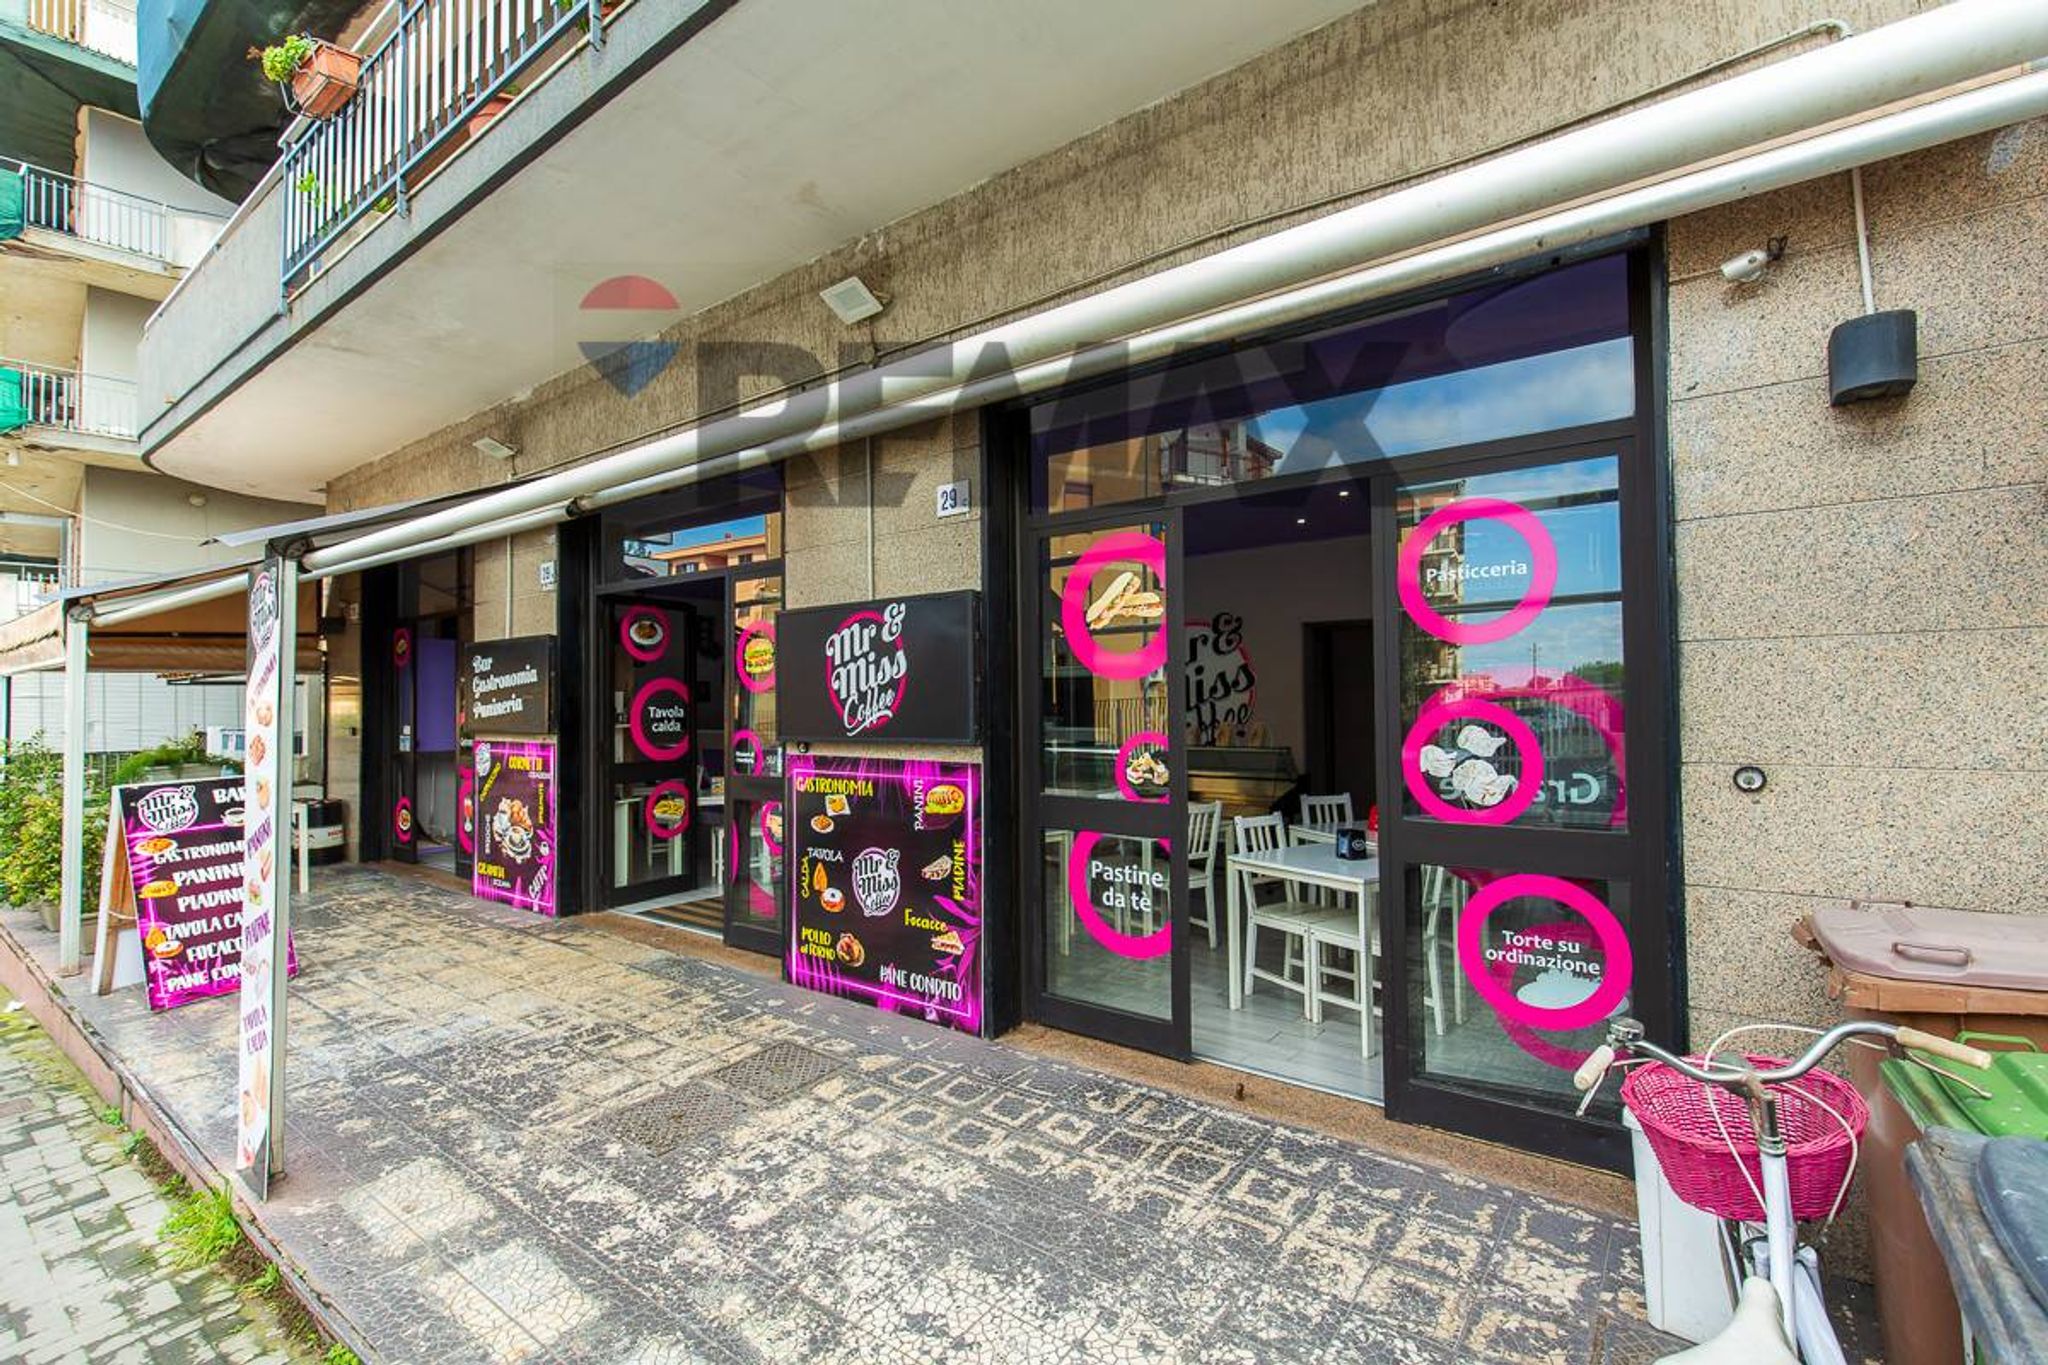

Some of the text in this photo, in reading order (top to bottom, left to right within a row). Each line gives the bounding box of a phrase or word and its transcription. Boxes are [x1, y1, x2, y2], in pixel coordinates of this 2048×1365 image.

[941, 488, 957, 511] 29
[1426, 560, 1528, 583] Pasticceria
[826, 603, 906, 665] Mr &
[1211, 612, 1242, 655] &
[473, 655, 493, 673] Bar
[831, 651, 907, 699] Miss
[473, 664, 538, 699] Gastronomia
[648, 705, 684, 718] Tavola
[844, 688, 894, 735] Coffee
[652, 719, 681, 732] calda
[796, 777, 873, 797] GASTRONOMIA
[141, 793, 175, 810] Mr
[914, 778, 925, 831] PANINI
[807, 848, 843, 862] TAVOLA
[854, 849, 900, 876] Mr &
[801, 856, 810, 898] CALDA
[952, 838, 965, 901] PIADINE
[1091, 861, 1164, 888] Pastine
[857, 873, 898, 895] Miss
[1102, 886, 1151, 912] da tè
[165, 917, 222, 941] TAVOLA
[801, 926, 832, 945] POLLO
[808, 944, 836, 960] FORNO
[1502, 930, 1580, 953] Torte su
[1485, 949, 1601, 974] ordinazione
[166, 970, 209, 992] PANE
[880, 965, 962, 1001] PANE CONDITO
